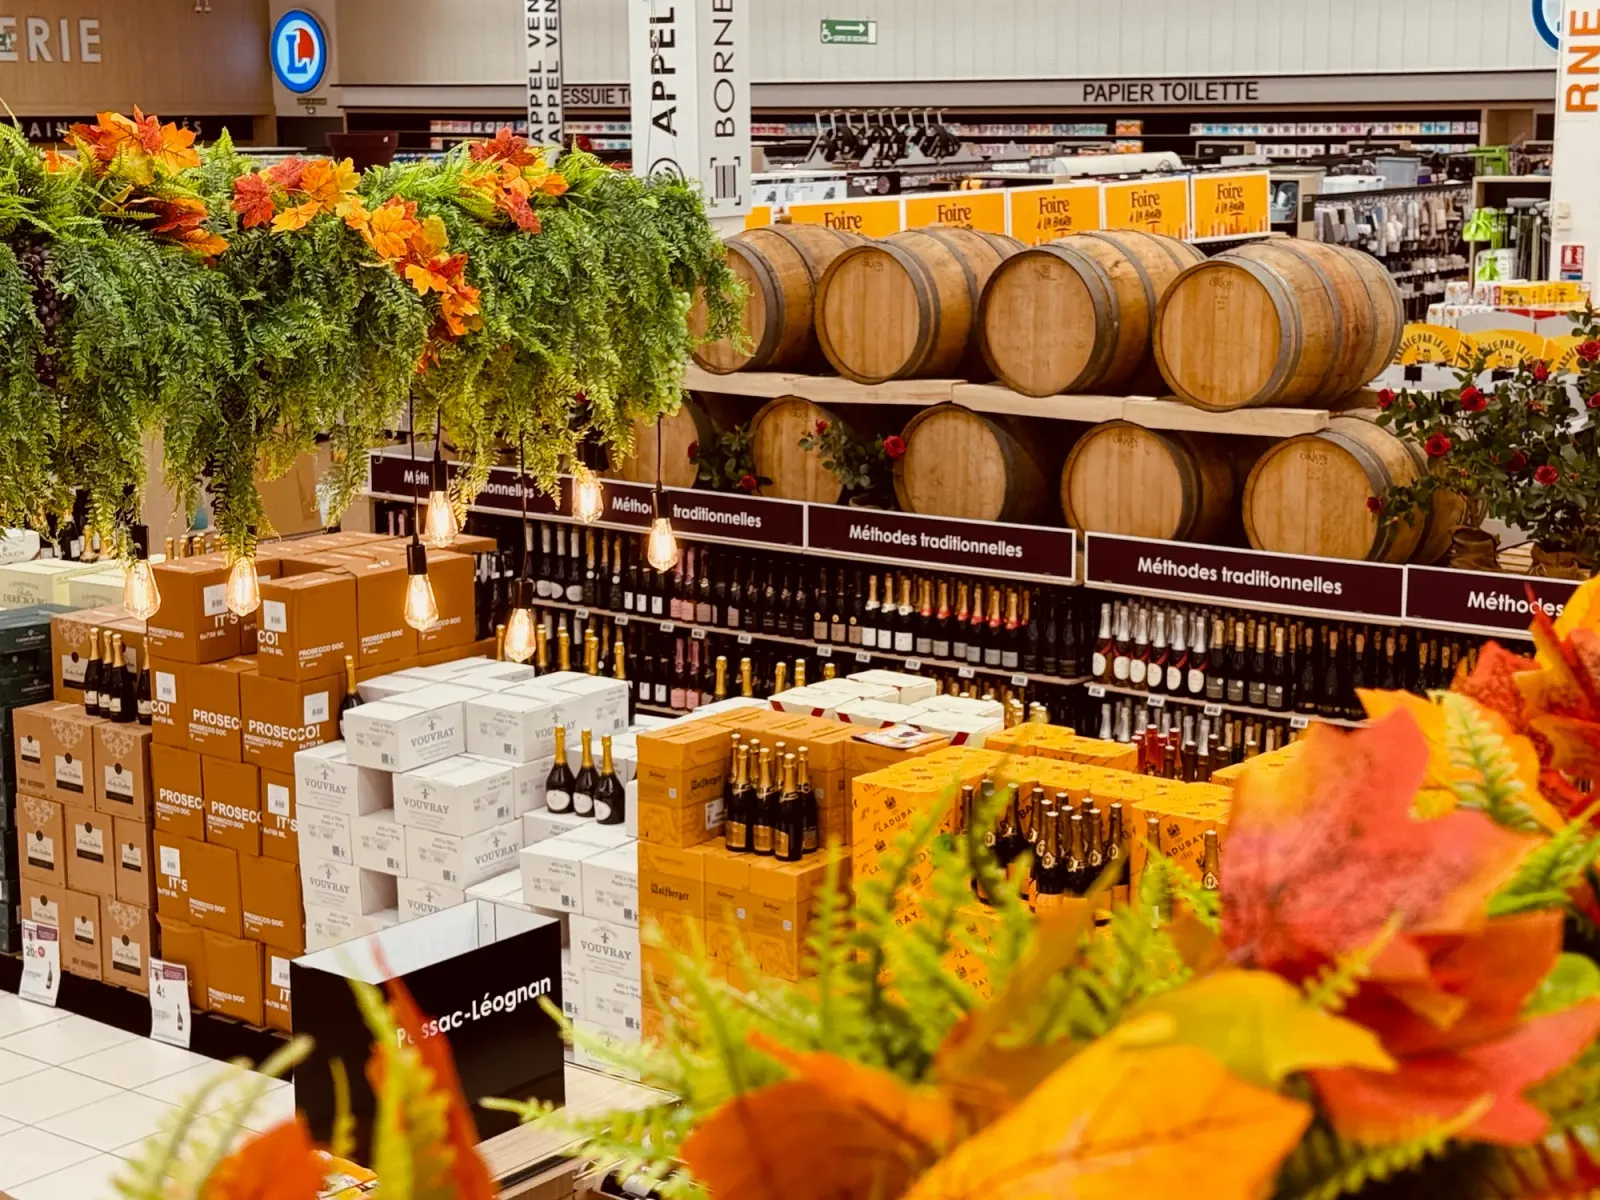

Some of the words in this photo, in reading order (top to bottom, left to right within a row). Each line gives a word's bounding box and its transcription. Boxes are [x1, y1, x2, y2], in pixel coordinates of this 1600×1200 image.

[650, 7, 677, 137] APPEL
[712, 0, 735, 137] BORNE
[529, 60, 543, 143] APPEL
[546, 61, 560, 143] APPEL
[1083, 83, 1154, 102] PAPIER
[1159, 81, 1259, 101] TOILETTE
[1131, 190, 1160, 209] Foire
[1217, 182, 1243, 202] Foire
[937, 203, 972, 224] Foire
[1039, 196, 1070, 215] Foire
[824, 210, 863, 230] Foire
[673, 504, 762, 528] traditionnelles
[849, 524, 917, 546] Méthodes
[920, 532, 1023, 558] traditionnelles
[1137, 556, 1218, 582] Méthodes
[1221, 566, 1343, 595] traditionnelles
[1467, 591, 1564, 617] Méthodes
[215, 612, 239, 628] IT'S
[248, 719, 320, 741] PROSECCO!
[410, 727, 455, 748] VOUVRAY
[535, 720, 577, 739] VOUAY
[304, 778, 347, 795] VOUVRAY
[403, 797, 449, 814] VOUVRAY
[475, 843, 519, 865] VOUVRAY
[1165, 833, 1204, 858] ADUBAY
[168, 876, 188, 892] IT'S
[309, 877, 350, 894] VOUVRAY
[580, 940, 632, 960] VOUVRAY
